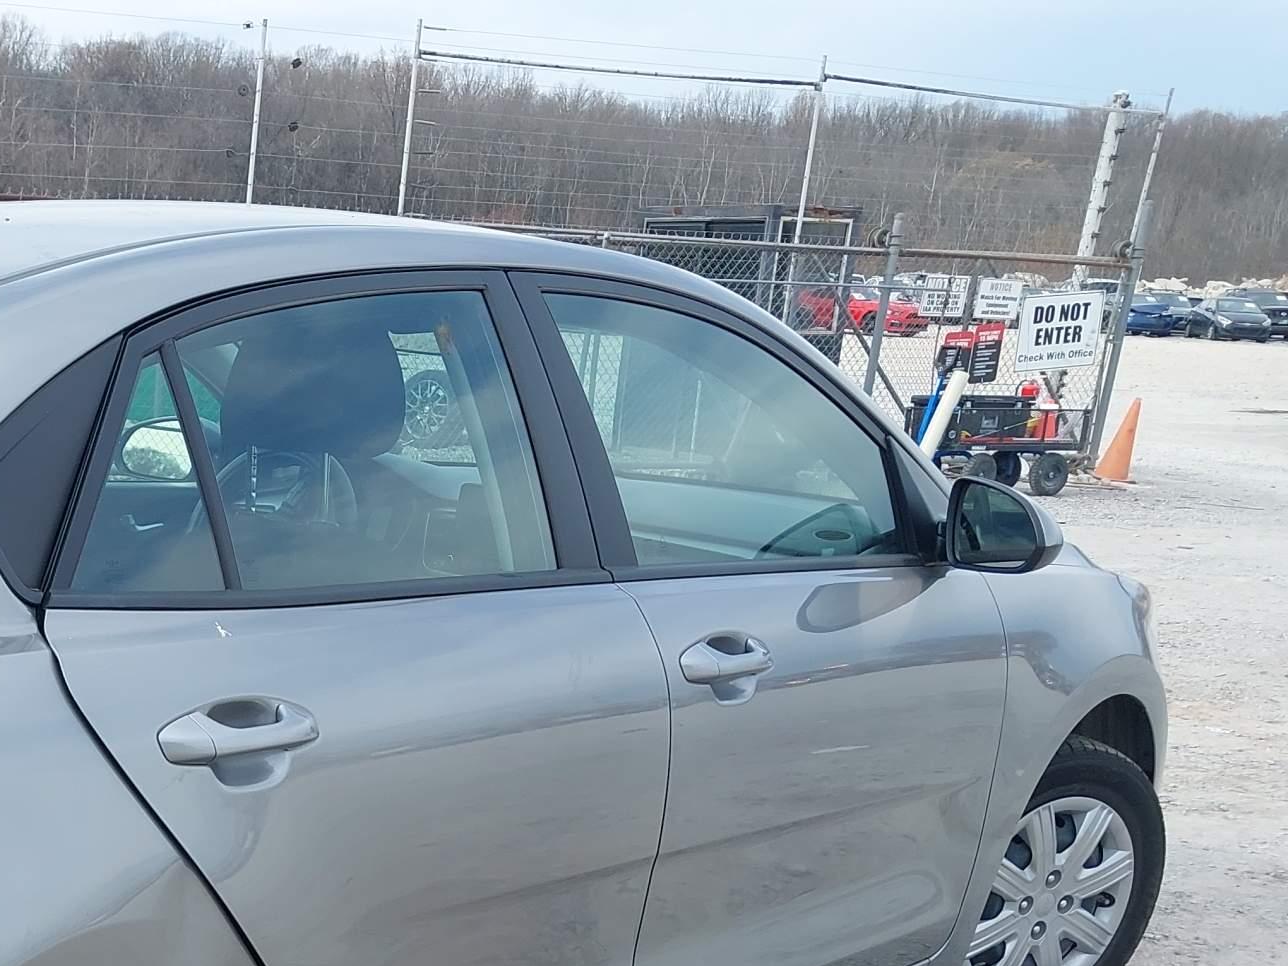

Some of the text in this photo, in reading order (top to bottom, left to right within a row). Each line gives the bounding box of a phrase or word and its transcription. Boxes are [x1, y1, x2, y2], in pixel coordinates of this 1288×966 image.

[1033, 302, 1092, 324] DO NOT
[1034, 325, 1083, 346] ENTER
[1017, 348, 1094, 363] Check With Office
